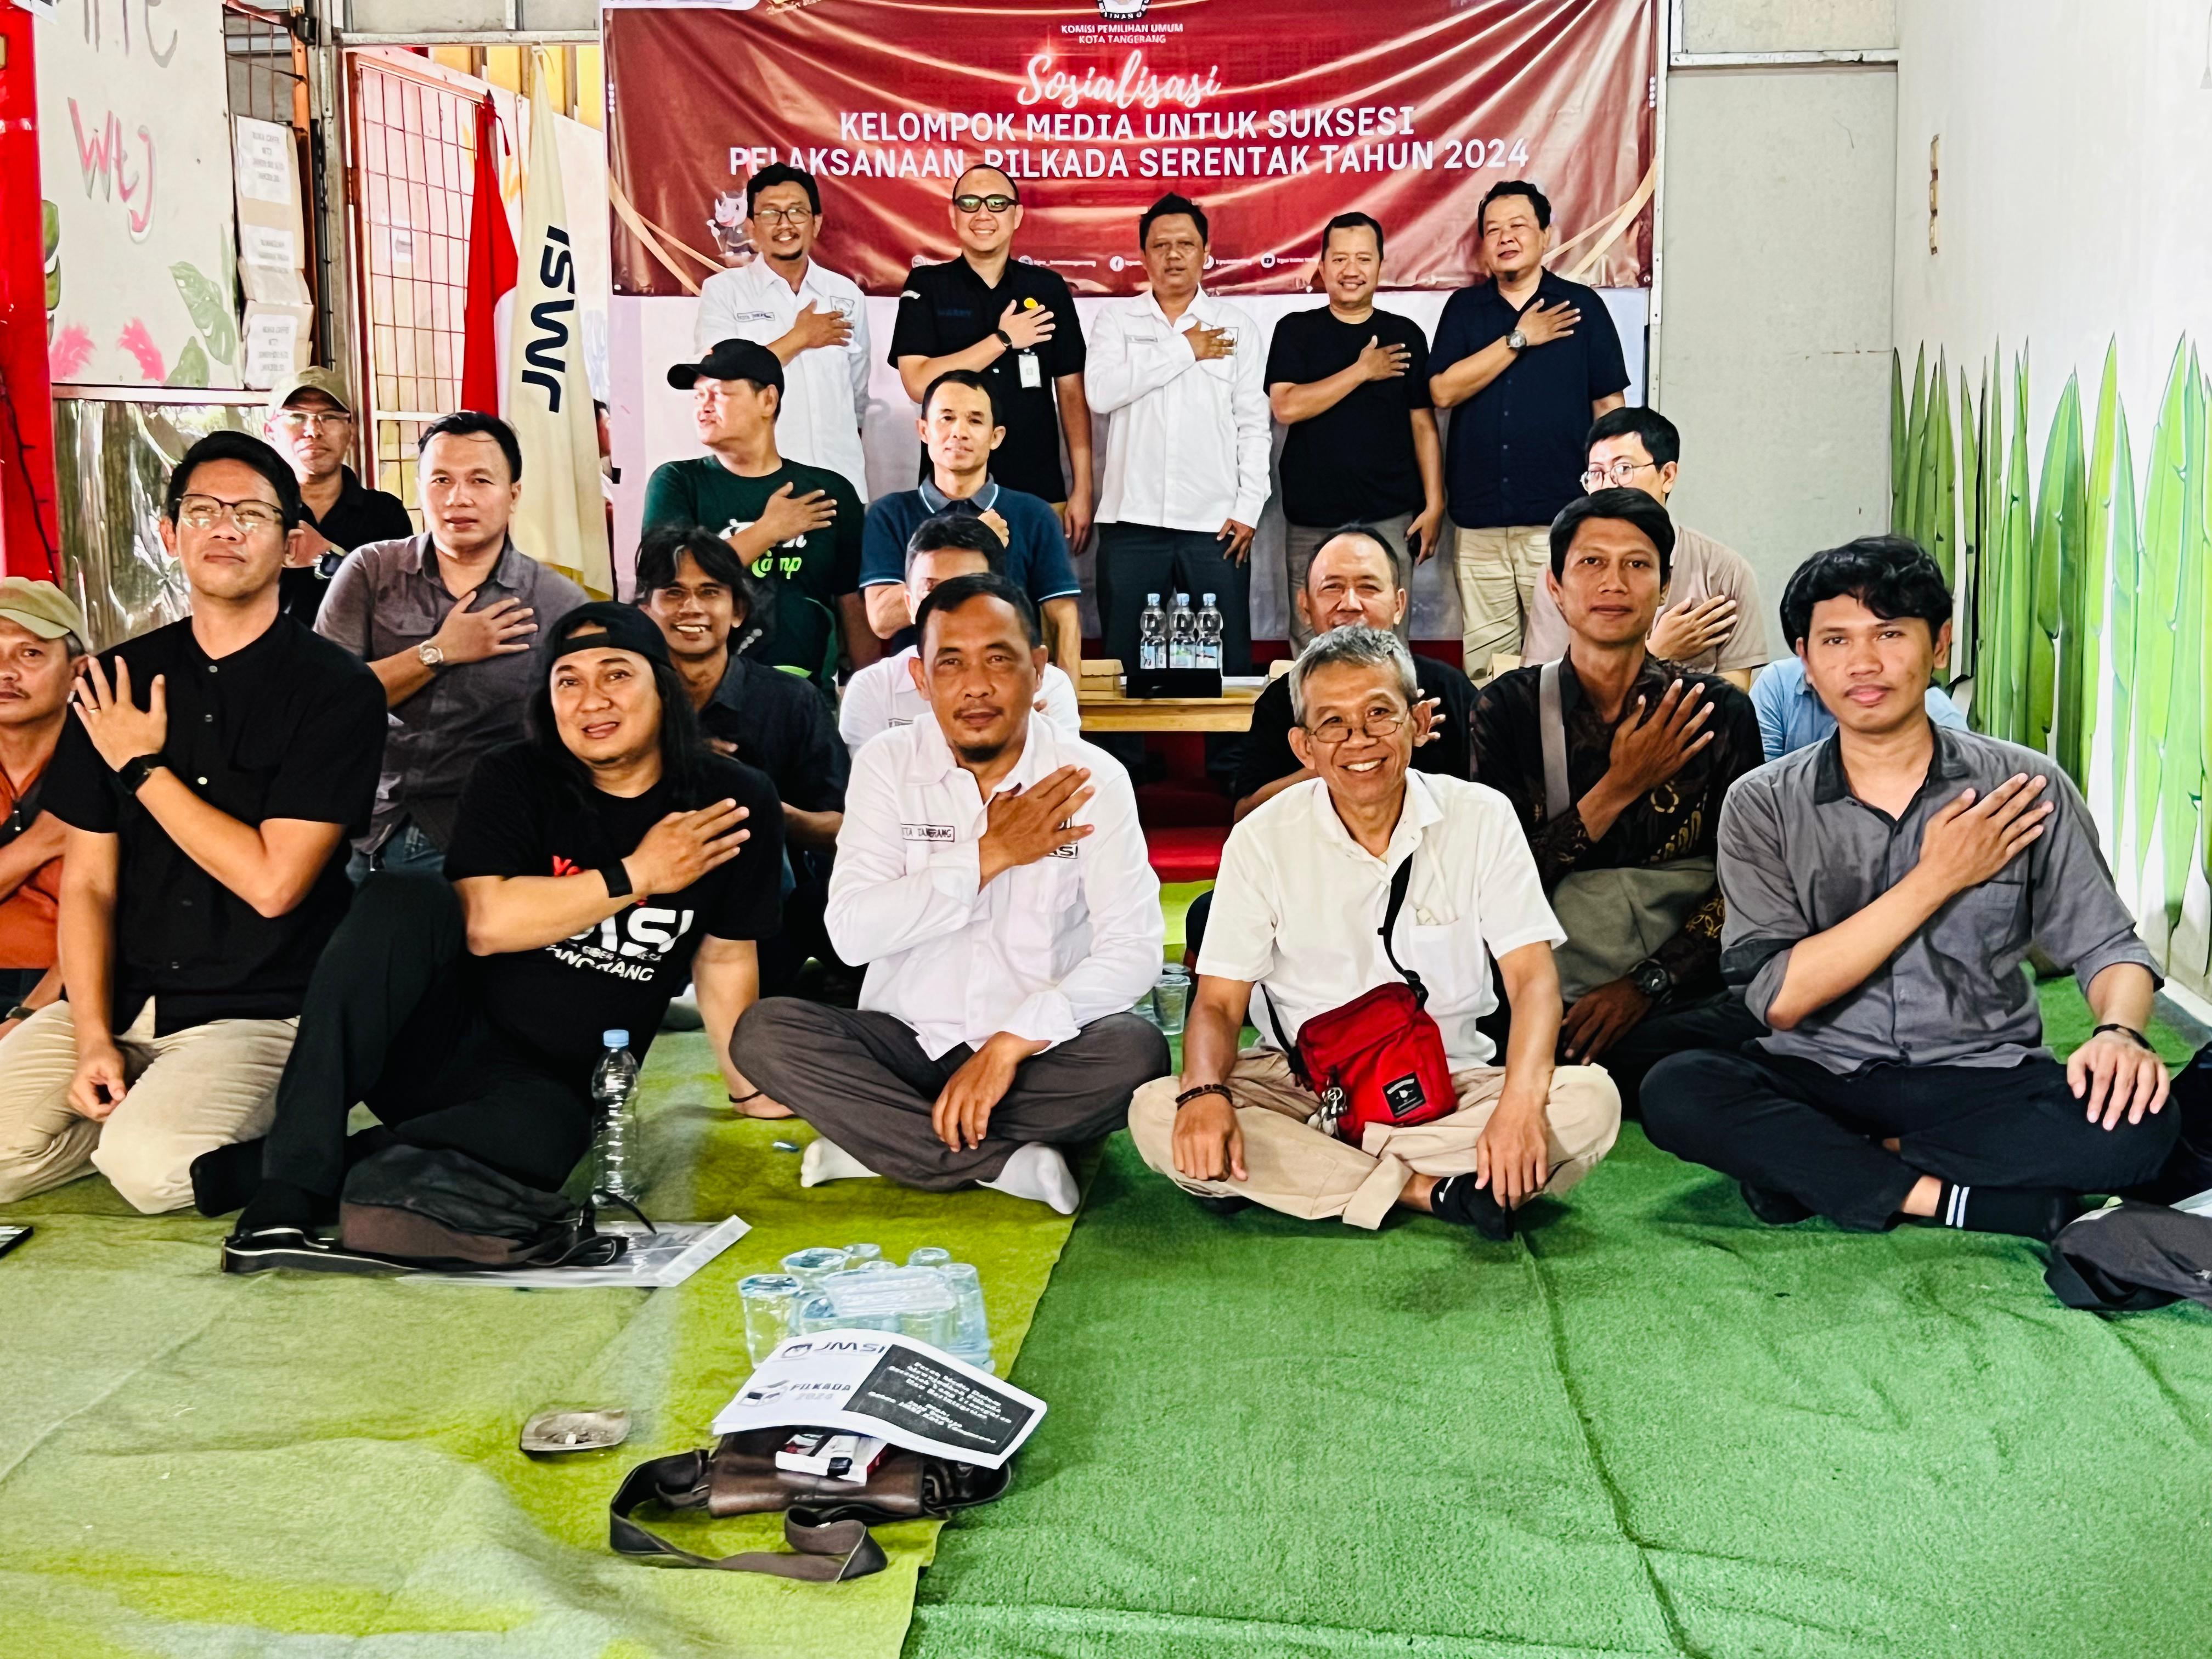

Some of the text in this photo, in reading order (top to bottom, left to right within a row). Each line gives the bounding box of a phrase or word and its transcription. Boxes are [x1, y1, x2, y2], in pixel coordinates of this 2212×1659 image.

[1061, 24, 1183, 33] KOMISI PEMILIHAN UMUM
[1079, 35, 1166, 44] KOTA TANGERANG
[1017, 50, 1221, 109] Sosialisasi
[840, 106, 1414, 142] KELOMPOK MEDIA UNTUK SUKSESI
[985, 149, 1128, 178] PILKADA
[1139, 145, 1310, 177] SERENTAK
[1319, 141, 1433, 173] TAHUN
[1444, 138, 1530, 169] 2024
[522, 225, 575, 413] JMSI
[814, 1342, 887, 1354] JMSI
